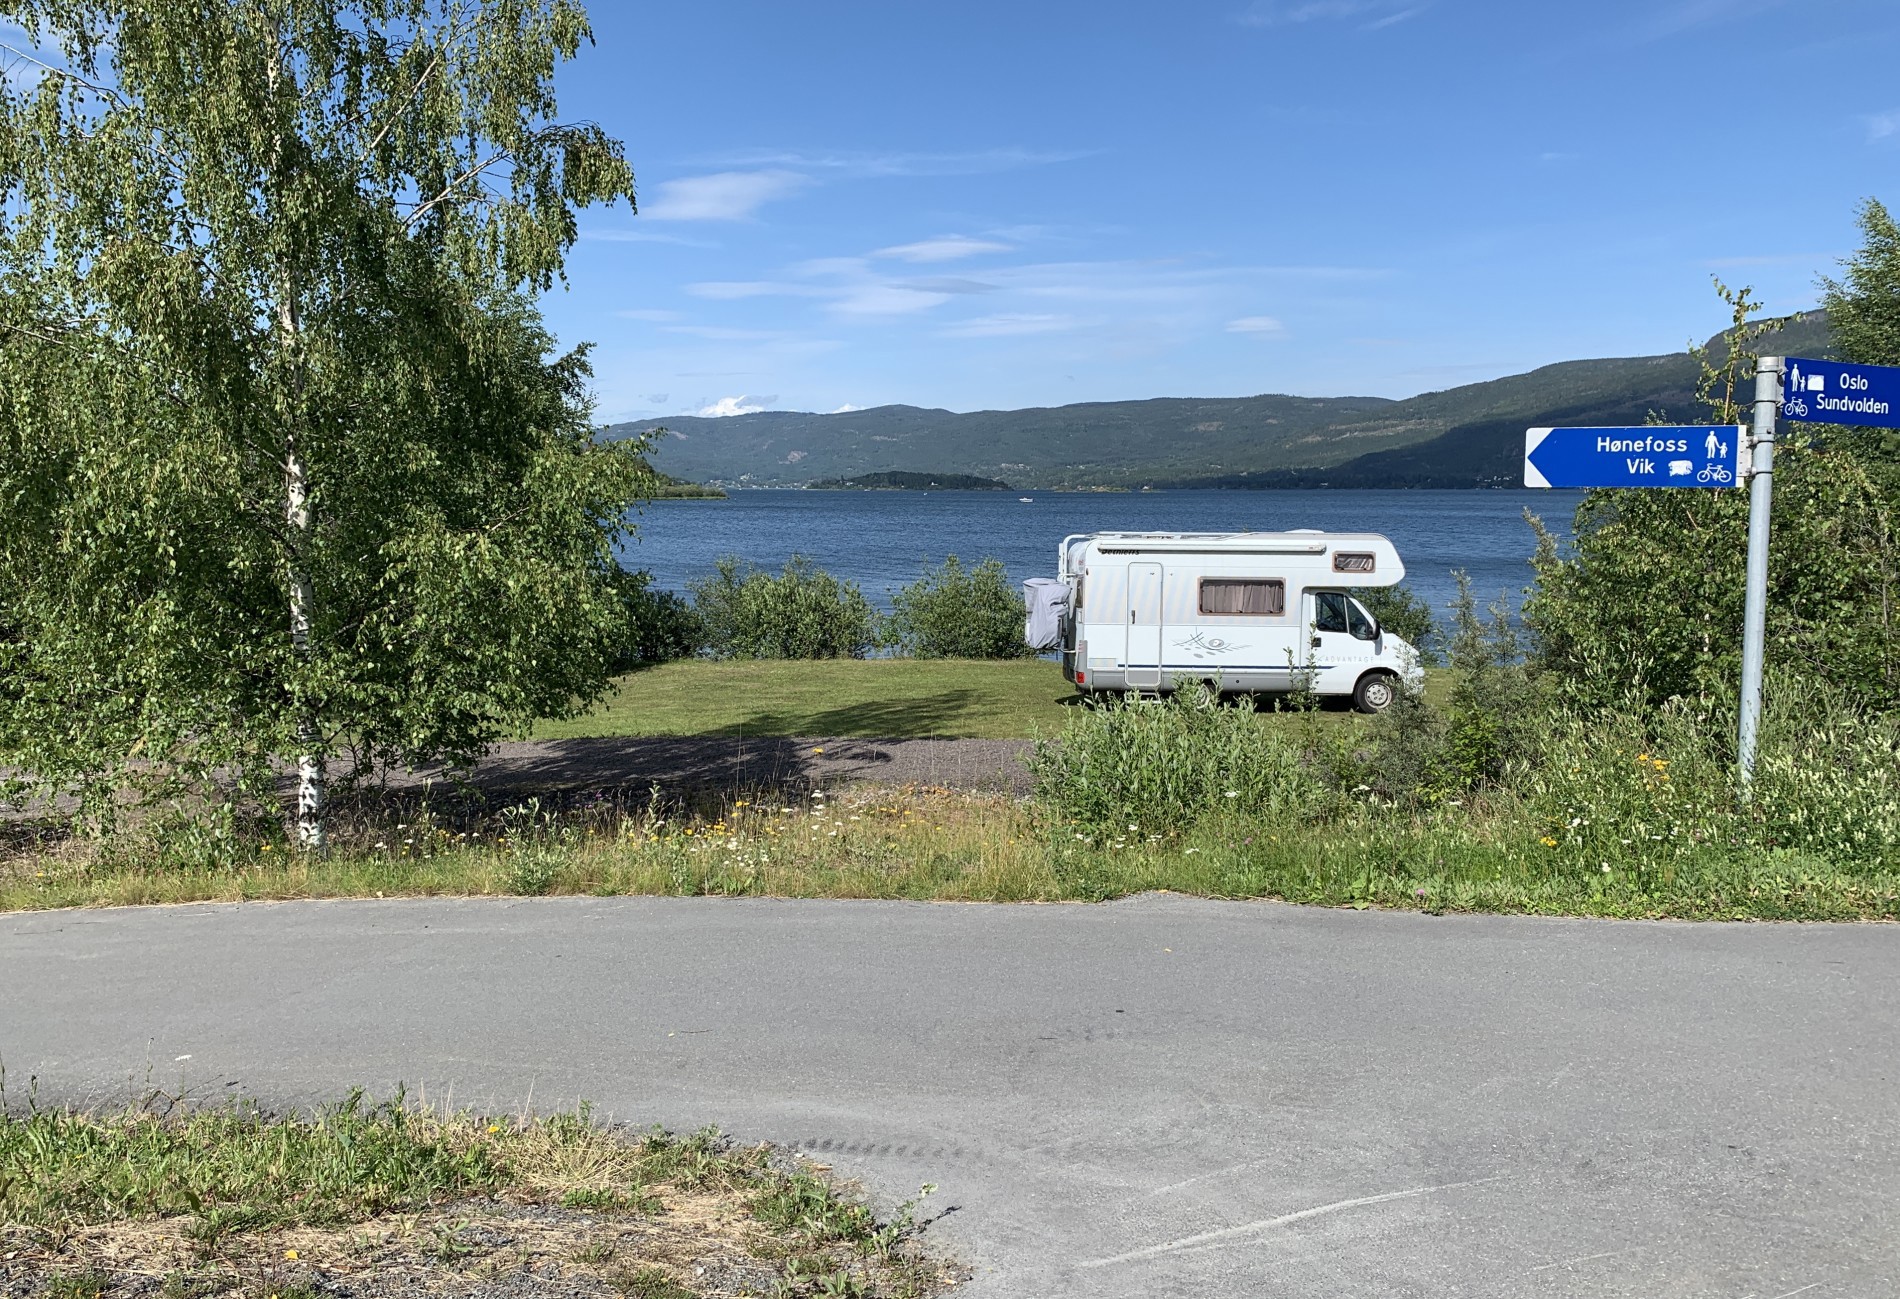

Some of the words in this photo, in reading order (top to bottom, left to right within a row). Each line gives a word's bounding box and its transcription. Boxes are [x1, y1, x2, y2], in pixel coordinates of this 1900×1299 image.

[1839, 372, 1868, 391] Oslo
[1816, 393, 1889, 414] Sundvolden
[1597, 436, 1688, 453] Hønefoss
[1626, 458, 1655, 474] Vik
